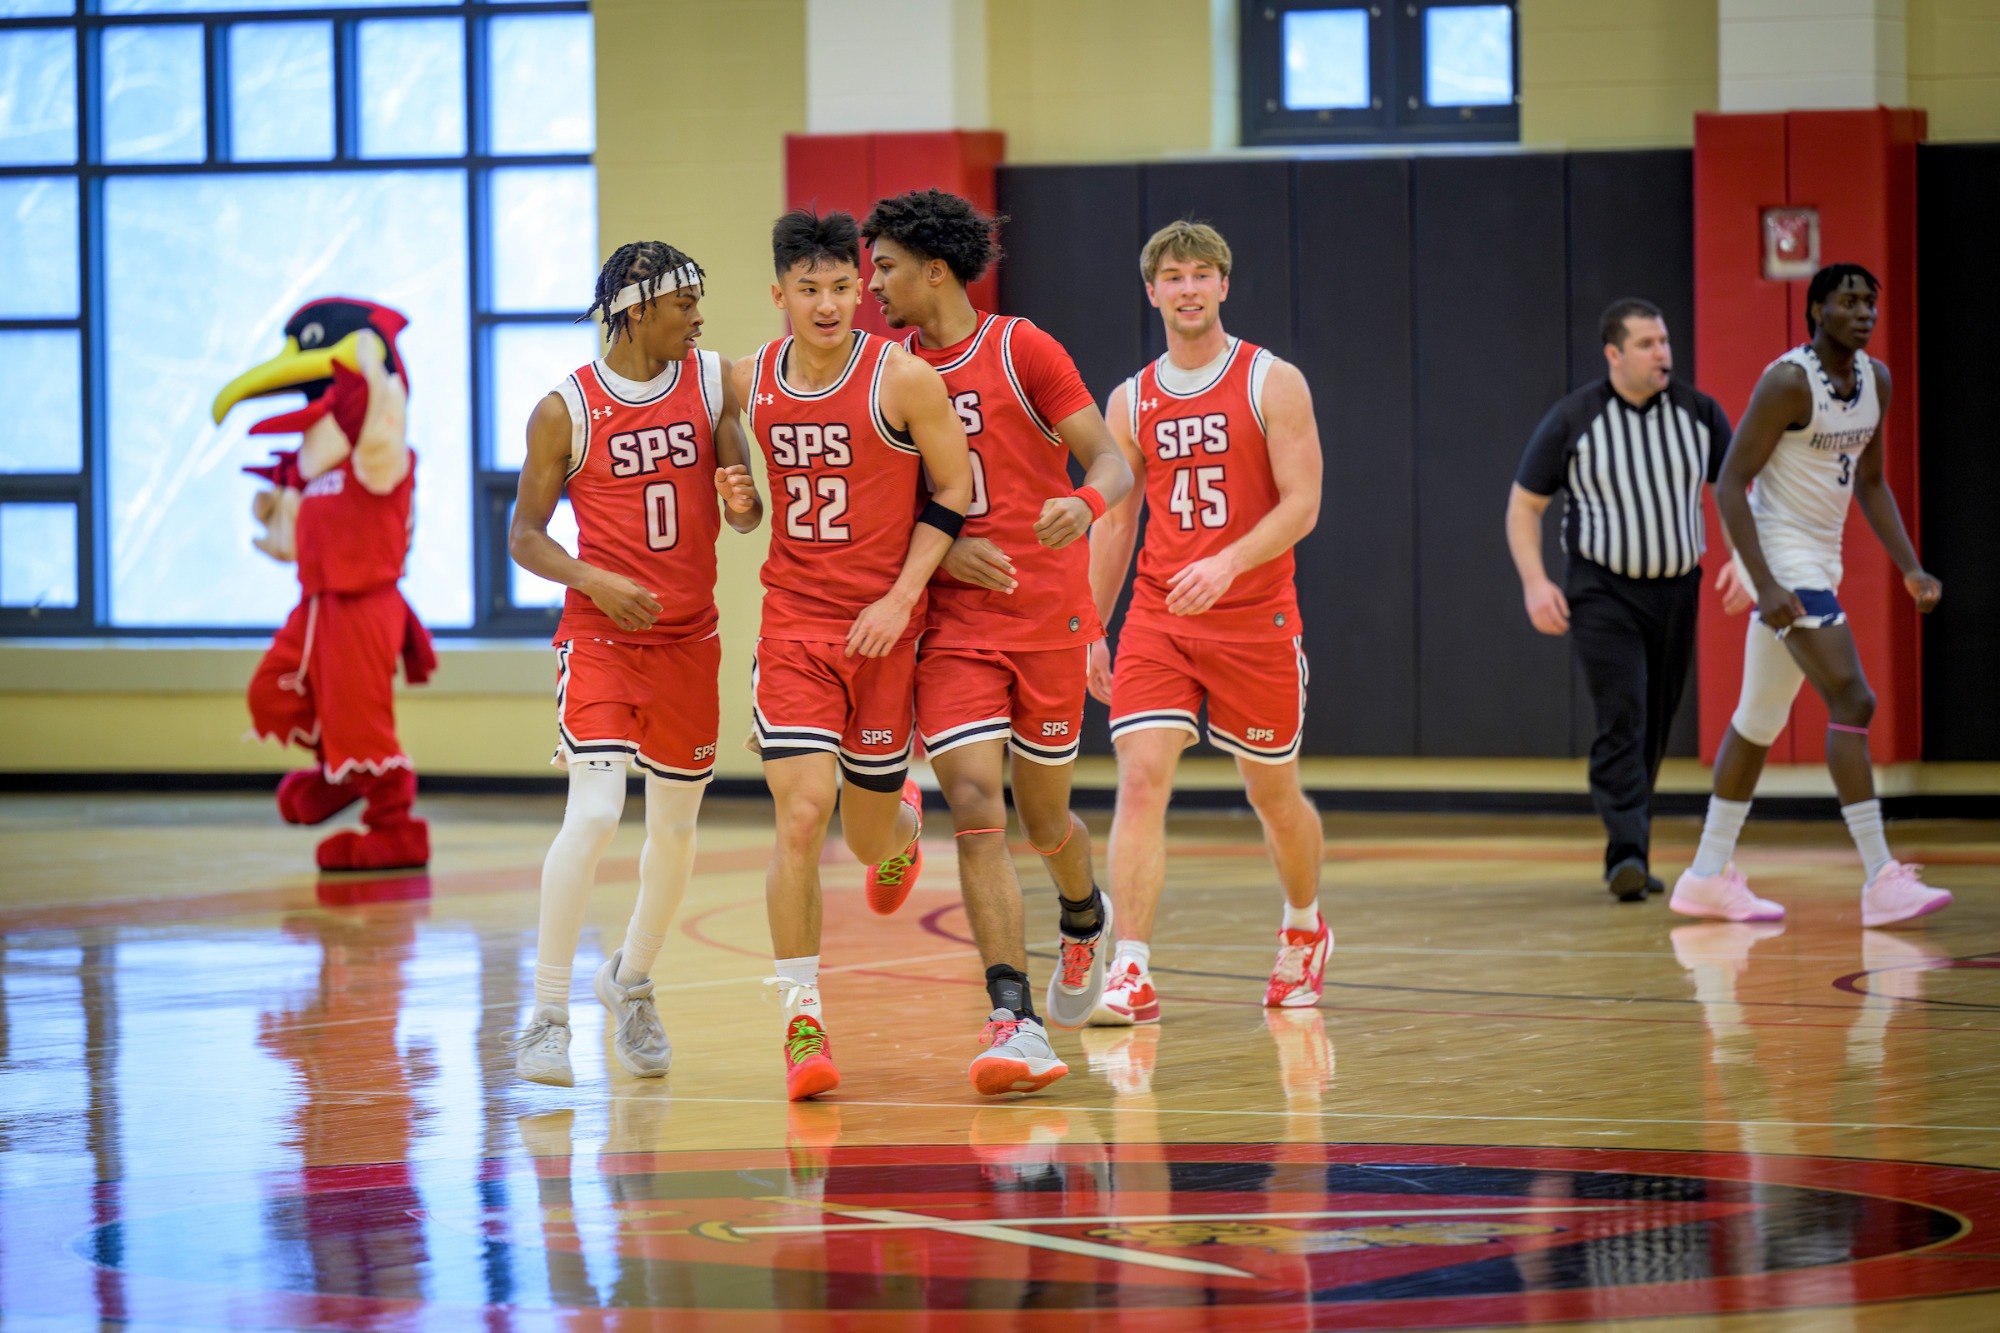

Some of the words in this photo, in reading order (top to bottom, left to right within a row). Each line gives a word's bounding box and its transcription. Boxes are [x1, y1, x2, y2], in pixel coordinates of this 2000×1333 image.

[608, 420, 698, 478] SPS
[769, 422, 854, 469] SPS
[1155, 412, 1229, 461] SPS
[1837, 453, 1850, 485] 3
[643, 480, 680, 553] 0
[784, 473, 852, 543] 22
[1169, 465, 1229, 531] 45
[692, 742, 716, 762] SPS
[861, 728, 893, 745] SPS
[1041, 720, 1069, 737] SPS
[1245, 727, 1275, 743] SPS
